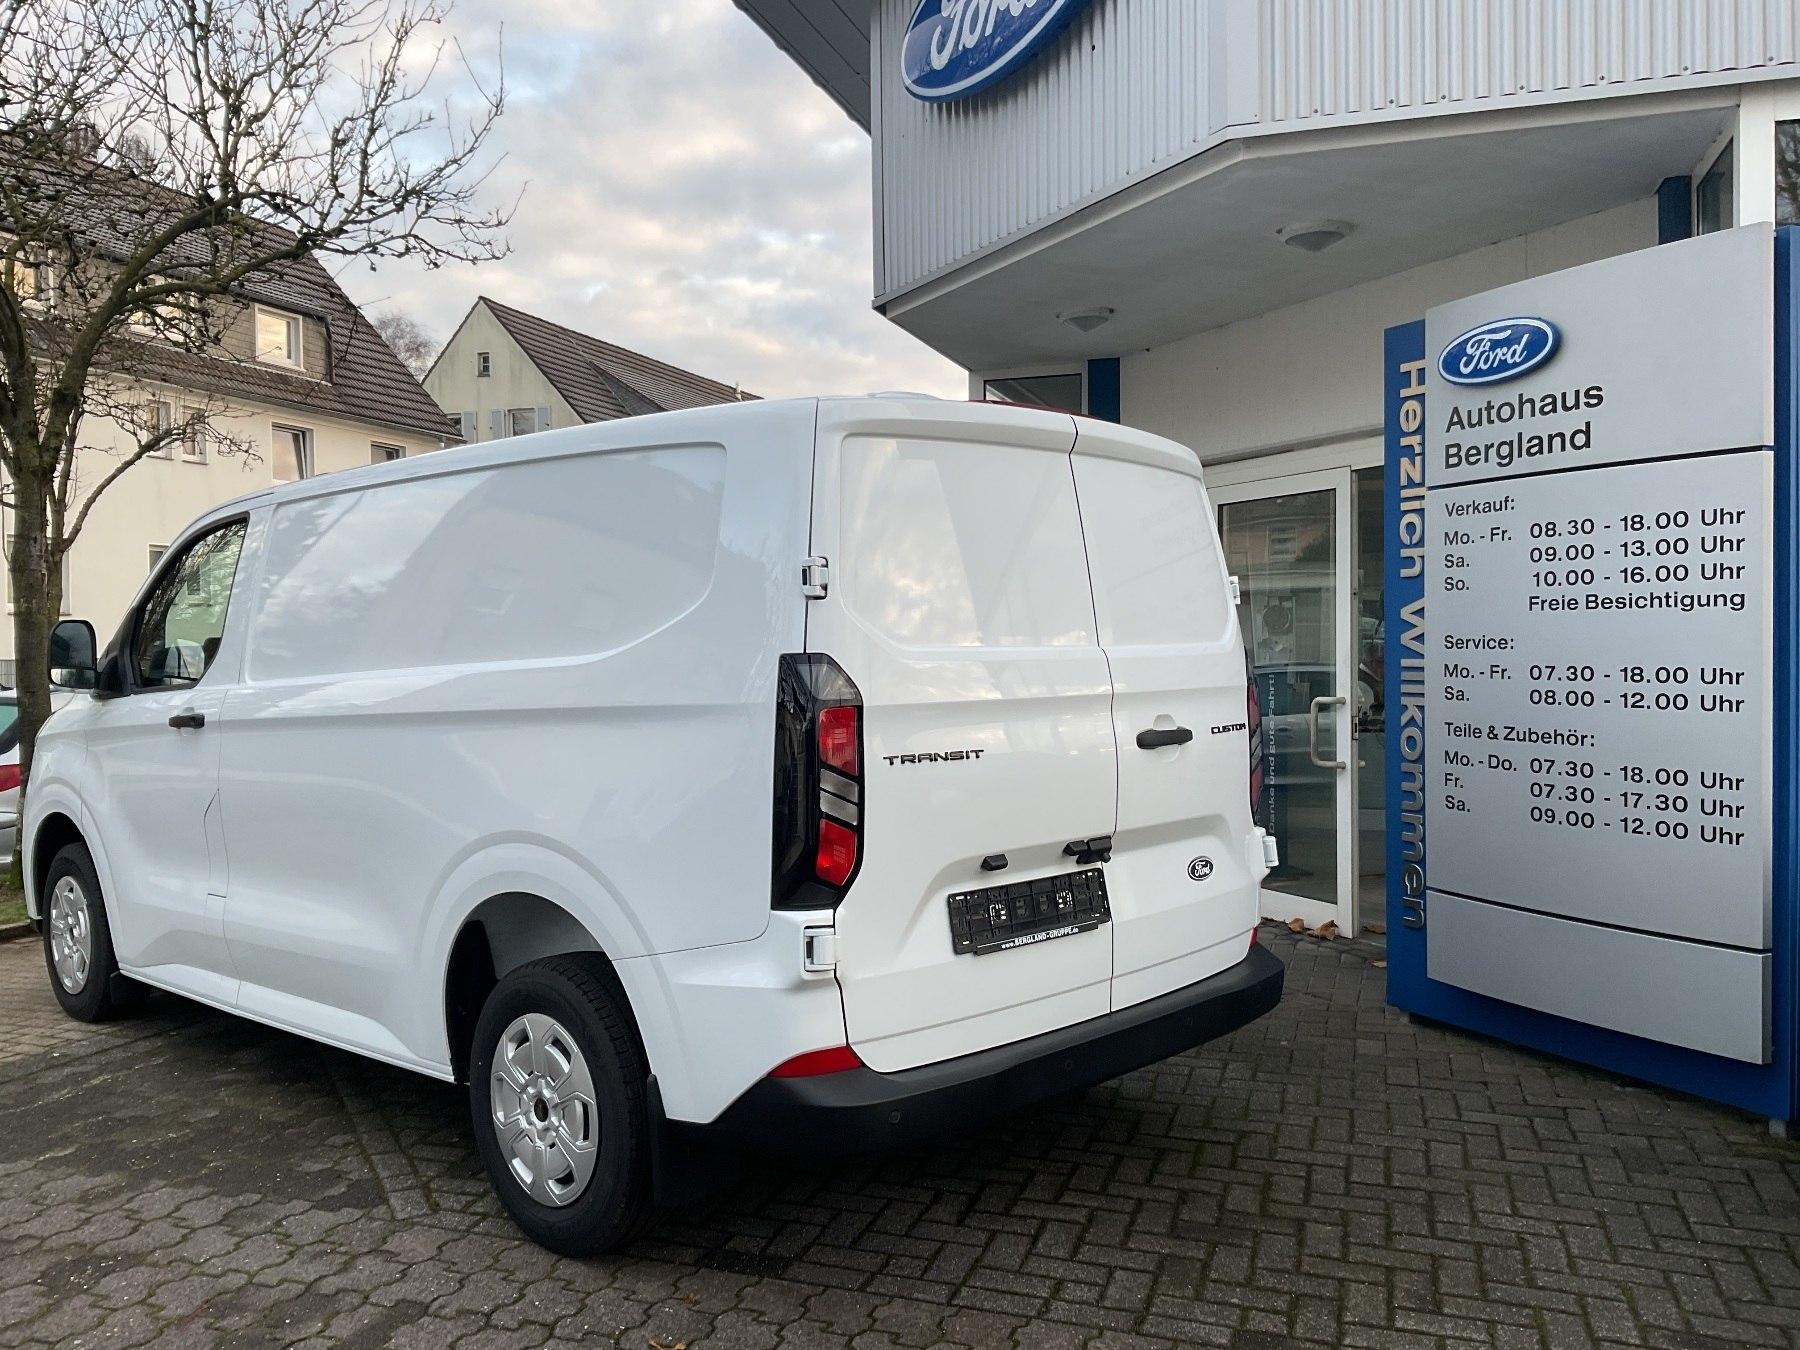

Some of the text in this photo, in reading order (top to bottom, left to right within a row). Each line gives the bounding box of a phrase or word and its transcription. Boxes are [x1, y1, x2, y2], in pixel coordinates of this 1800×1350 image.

[931, 0, 1038, 70] For
[1445, 384, 1603, 433] Autohaus
[1444, 421, 1591, 470] Bergland
[1445, 496, 1514, 518] Verkauf:
[1530, 519, 1594, 538] 08.30
[1620, 511, 1689, 531] 18.00
[1701, 508, 1745, 526] Uhr
[1445, 554, 1469, 568] Sa.
[1529, 544, 1594, 563] 09.00
[1620, 536, 1689, 557] 13.00
[1701, 535, 1747, 553] Uhr
[1444, 577, 1469, 591] So.
[1532, 569, 1594, 587] 10.00
[1620, 564, 1689, 583] 16.00
[1701, 563, 1746, 582] Uhr
[1529, 591, 1745, 613] Freie Besichtigung
[1399, 359, 1426, 929] Herzlich Willkommen
[1444, 635, 1513, 650] Service:
[1530, 665, 1594, 682] 07.30
[1620, 665, 1688, 686] 18.00
[1701, 668, 1744, 685] Uhr
[1445, 686, 1469, 701] Sa.
[1530, 689, 1594, 707] 08.00
[1620, 692, 1688, 710] 12.00
[1701, 694, 1744, 712] Uhr
[1211, 723, 1246, 734] CUSTOM
[1268, 718, 1276, 752] gute
[1444, 722, 1594, 747] Teile & Zubehör:
[883, 749, 985, 766] TRANSIT
[1530, 758, 1593, 778] 07.30
[1620, 766, 1688, 786] 18.00
[1701, 771, 1744, 791] Uhr
[1530, 782, 1594, 803] 07.30
[1620, 792, 1688, 812] 17.30
[1701, 798, 1744, 818] Uhr
[1445, 795, 1470, 812] Sa.
[1530, 806, 1594, 828] 09.00
[1620, 817, 1688, 839] 12.00
[1701, 825, 1744, 845] Uhr
